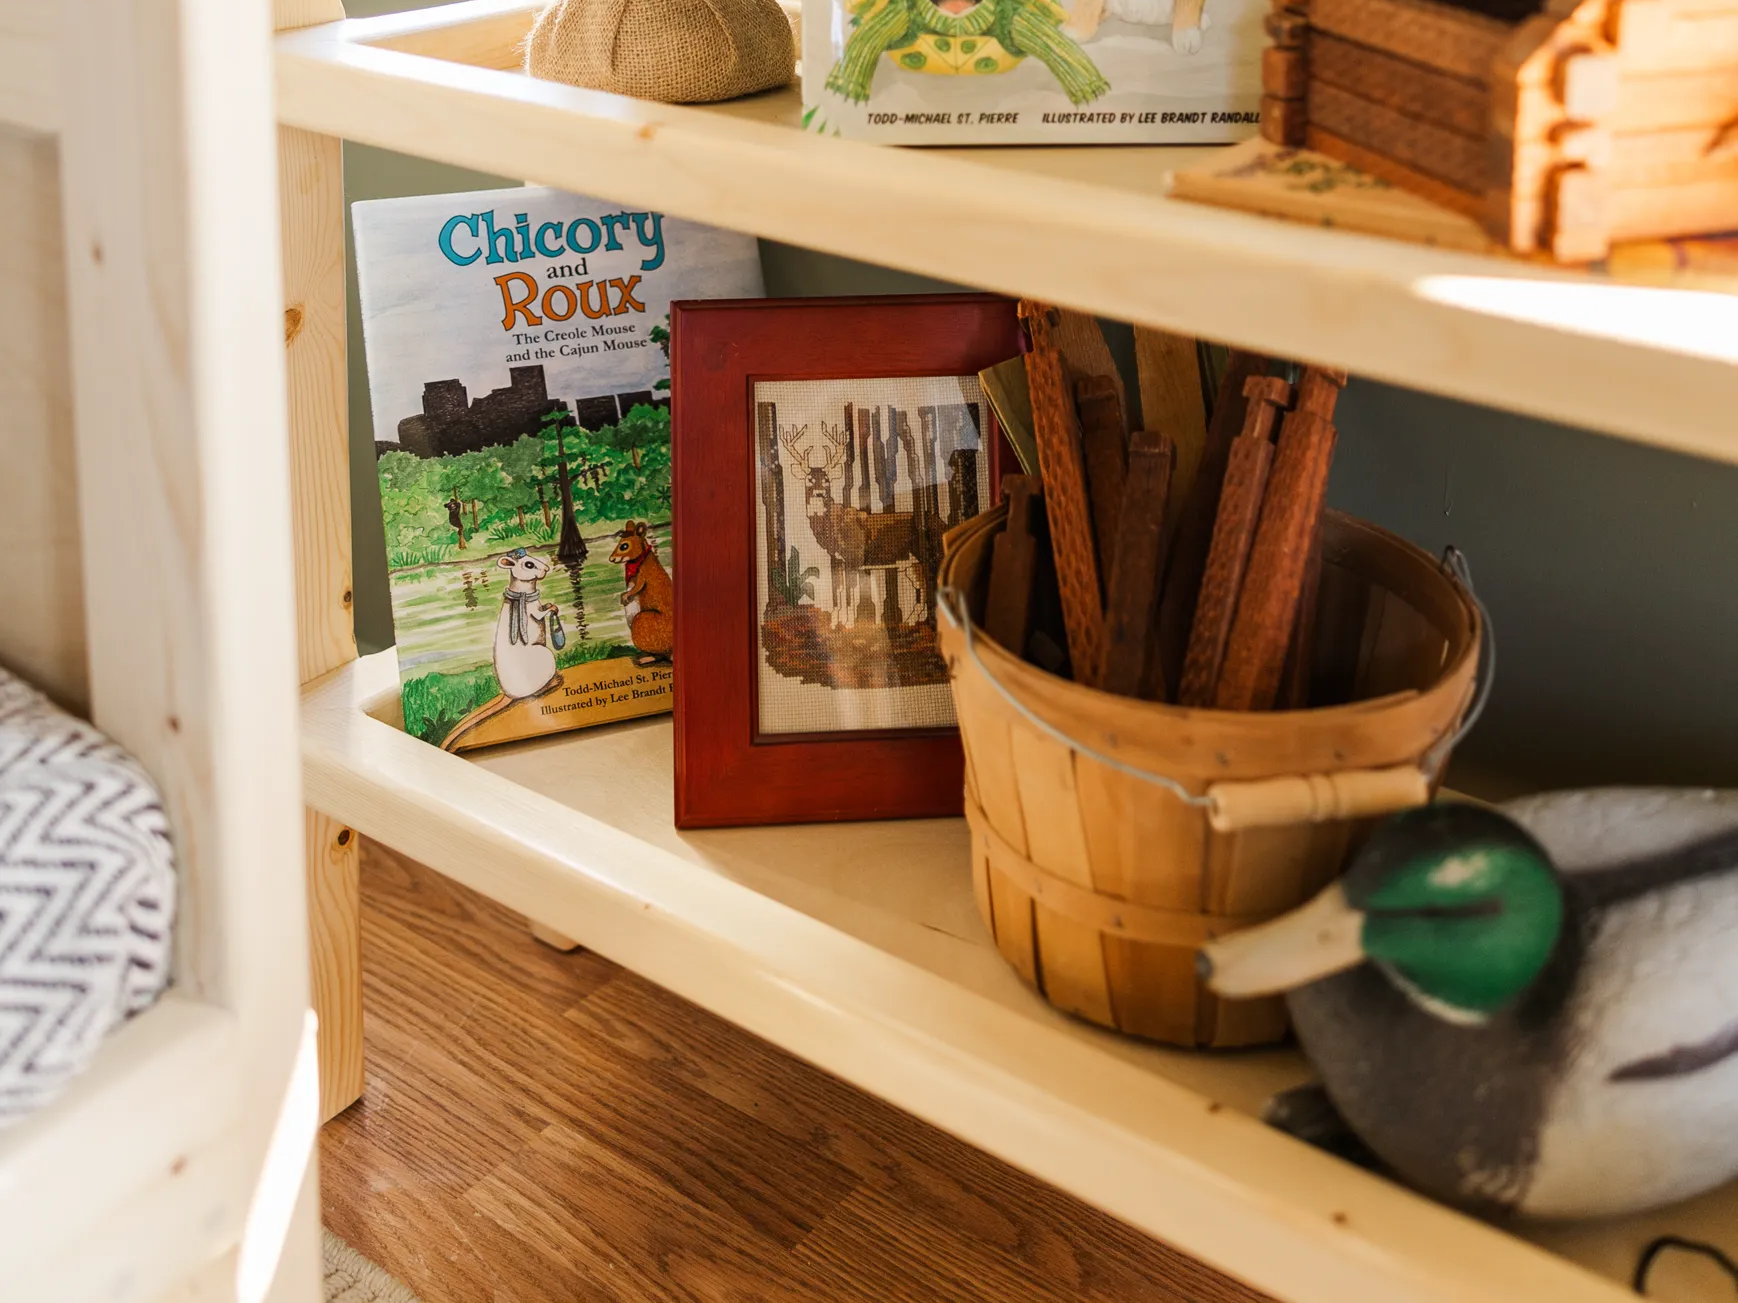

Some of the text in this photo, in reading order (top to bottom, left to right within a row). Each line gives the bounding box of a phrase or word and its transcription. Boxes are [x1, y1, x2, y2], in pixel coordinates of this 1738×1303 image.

[867, 112, 1019, 125] TODD-MICHAEL ST. PIERRE
[1042, 111, 1261, 124] ILLUSTRATED BY LEE BRANDT RANDALL
[438, 209, 665, 271] Chicory
[547, 258, 588, 280] and
[493, 271, 646, 332] Roux
[512, 323, 636, 345] The Creole Mouse
[506, 338, 647, 363] and the Cajun Mouse
[562, 677, 633, 697] Todd-Michael
[636, 674, 649, 684] St.
[540, 697, 593, 716] Illustrated
[595, 696, 608, 707] by
[610, 693, 629, 704] Lee
[632, 685, 666, 699] Brandt
